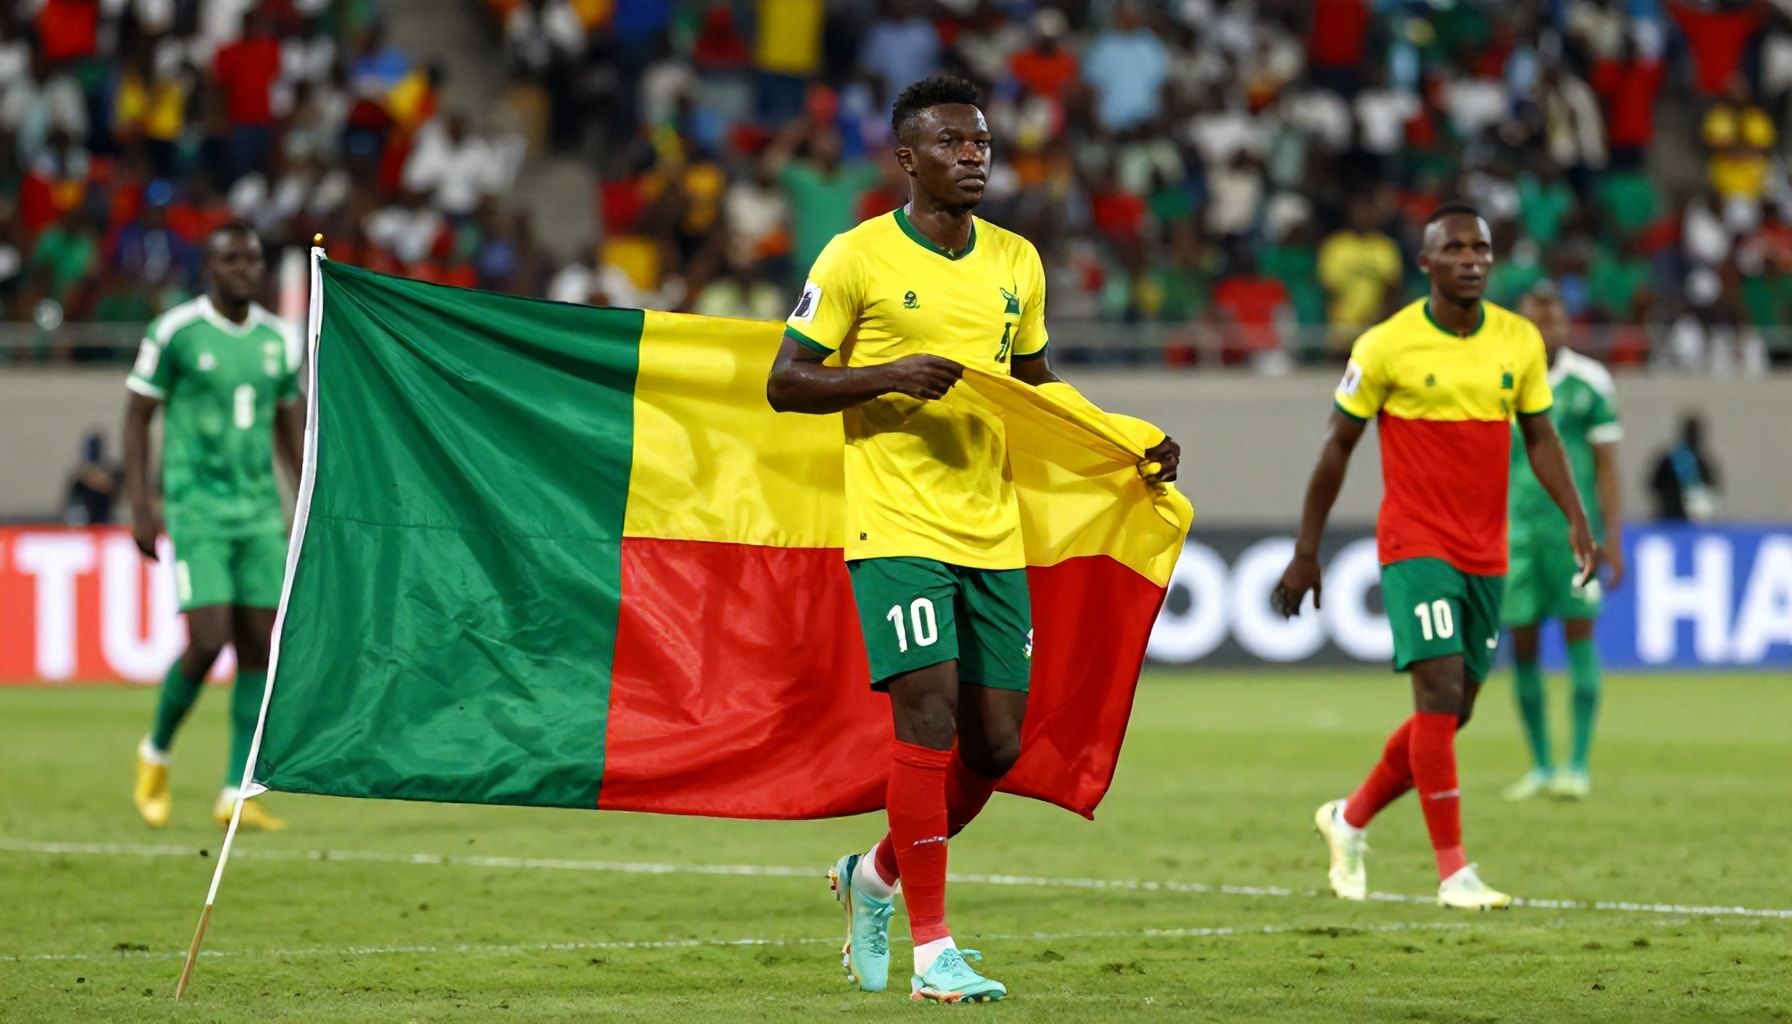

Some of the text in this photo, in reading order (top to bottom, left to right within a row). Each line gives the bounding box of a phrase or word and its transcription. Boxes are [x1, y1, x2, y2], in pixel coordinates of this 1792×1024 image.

[14, 532, 237, 682] TU
[886, 597, 938, 653] 10
[1414, 599, 1453, 641] 10
